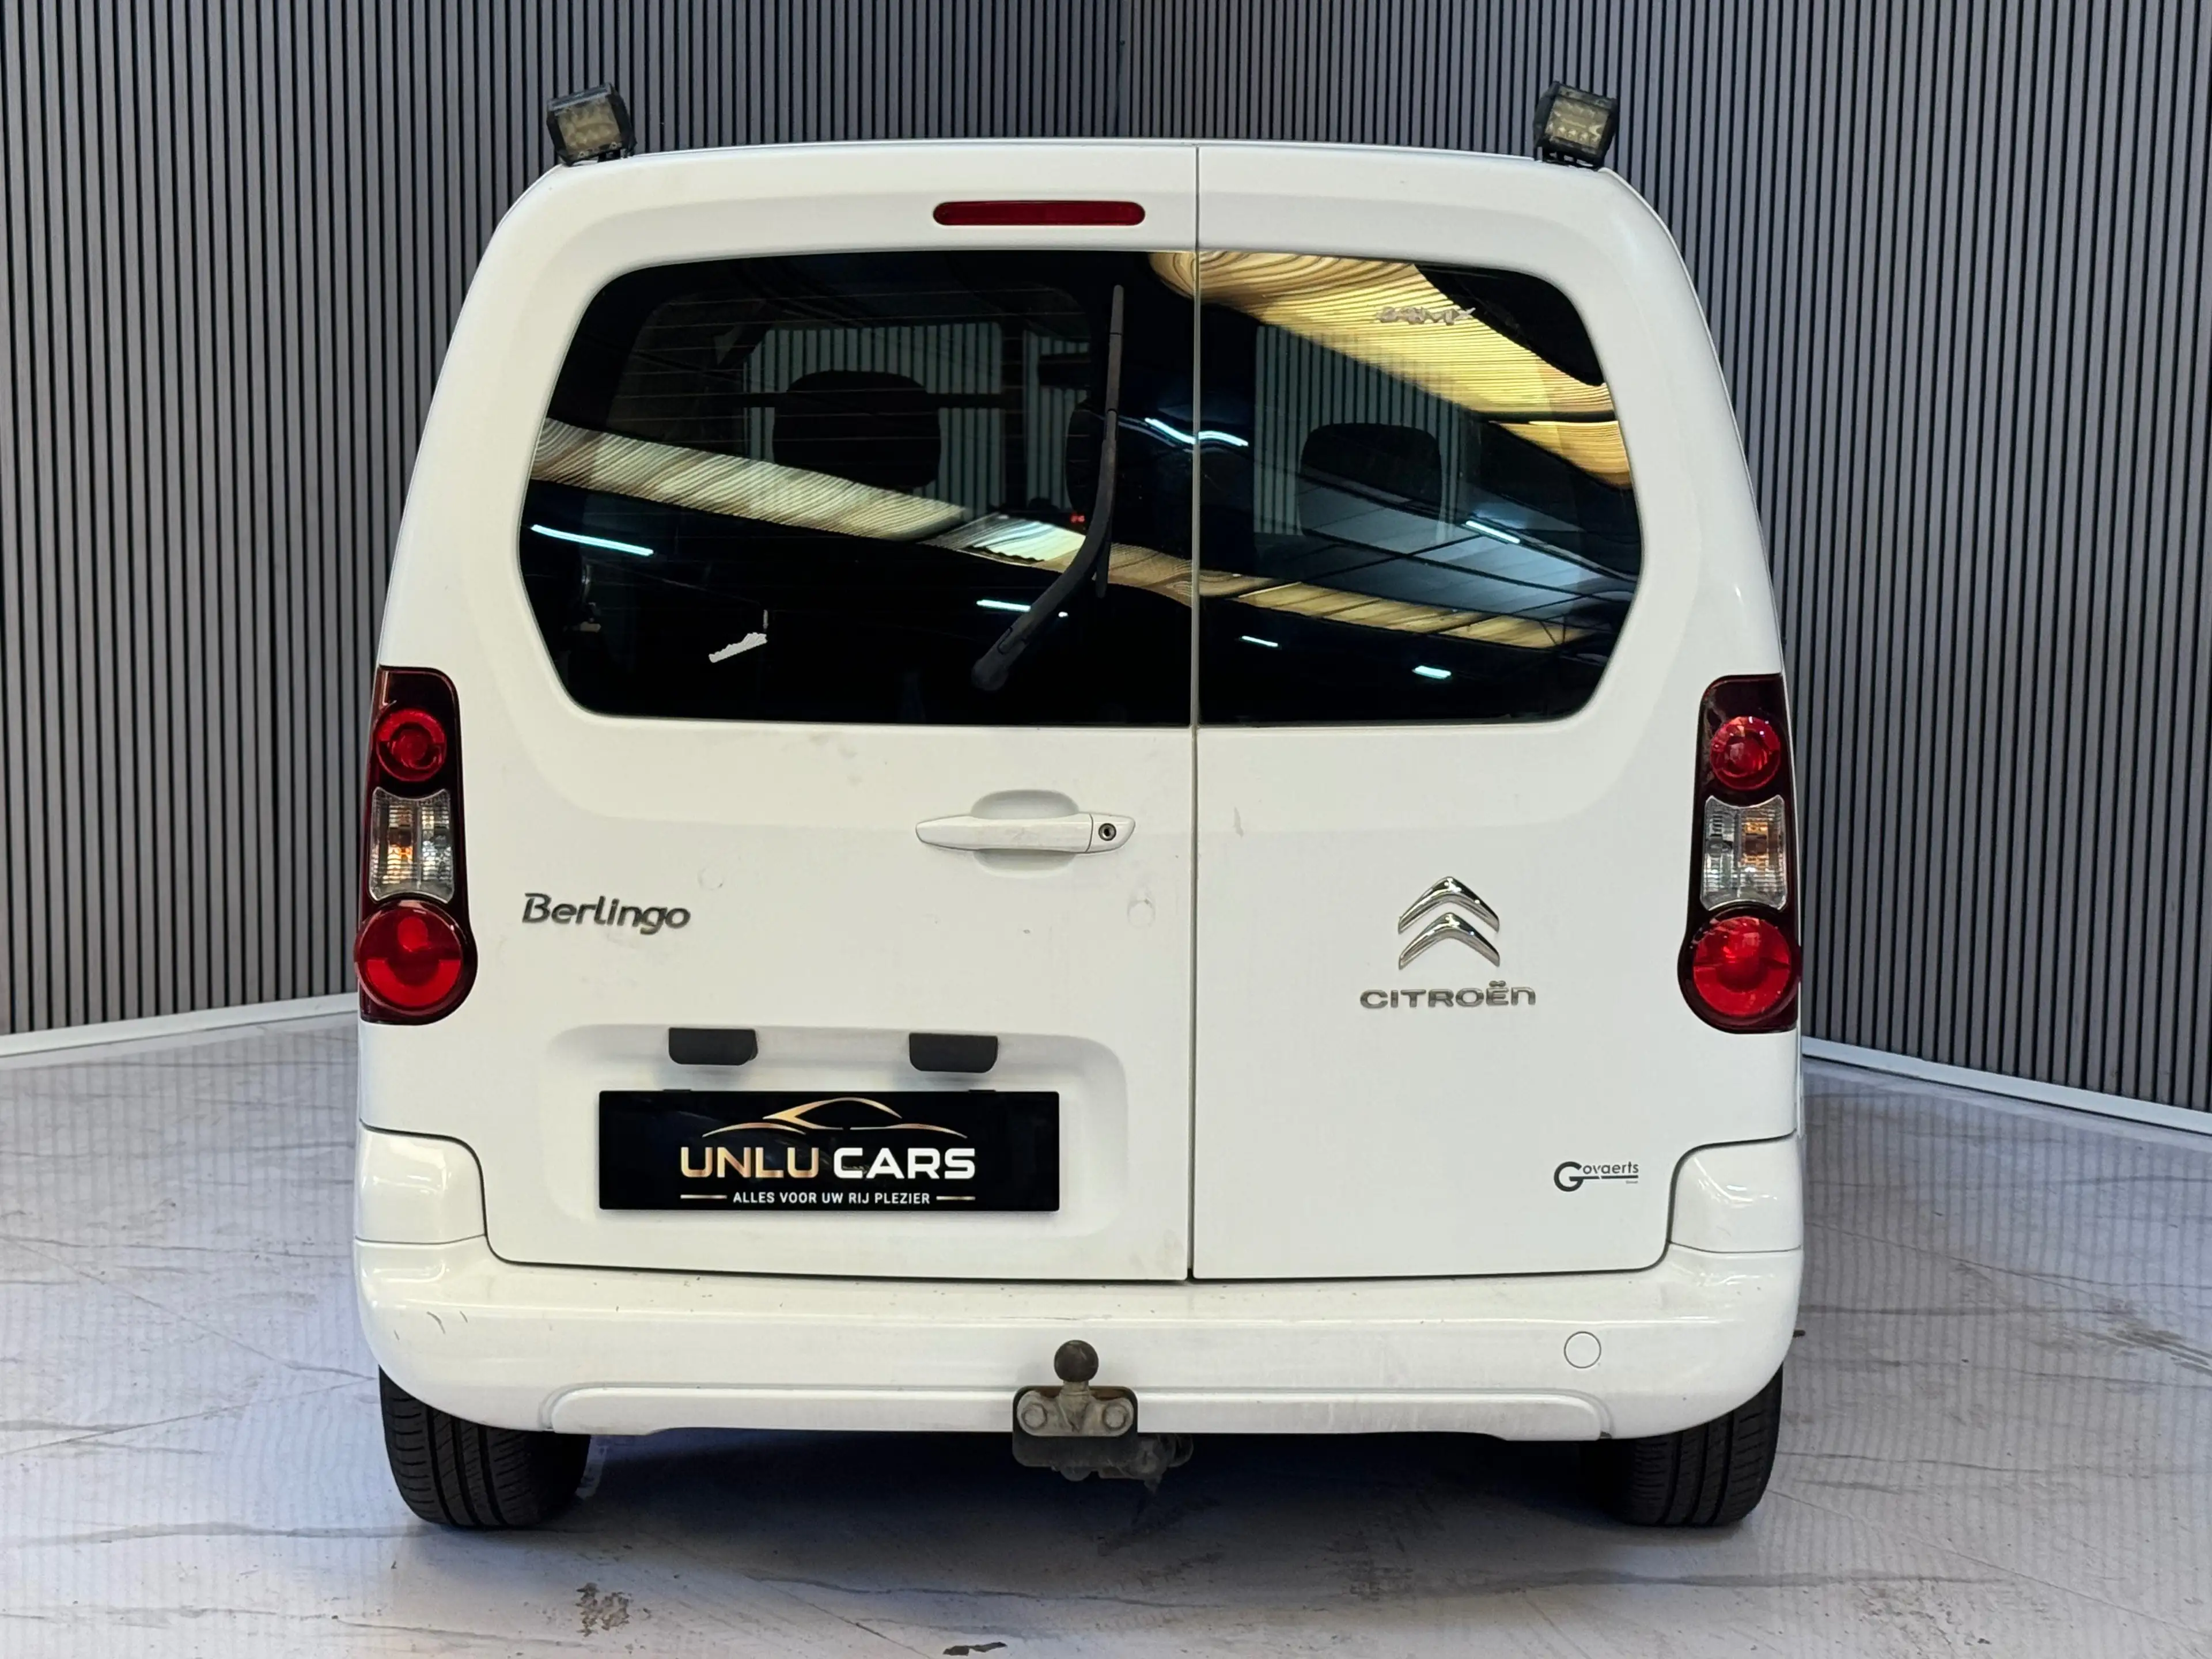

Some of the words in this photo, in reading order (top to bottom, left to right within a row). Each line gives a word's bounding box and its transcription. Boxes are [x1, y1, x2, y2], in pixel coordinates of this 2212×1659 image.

[522, 892, 691, 935] Berlingo
[680, 1146, 819, 1178] UNLU
[834, 1147, 975, 1179] CARS
[1553, 1161, 1639, 1192] Govaerts
[733, 1191, 775, 1204] ALLES
[779, 1191, 817, 1204] VOOR
[821, 1192, 843, 1204] UW
[849, 1192, 869, 1205] RIJ
[874, 1192, 930, 1205] PLEZIER
